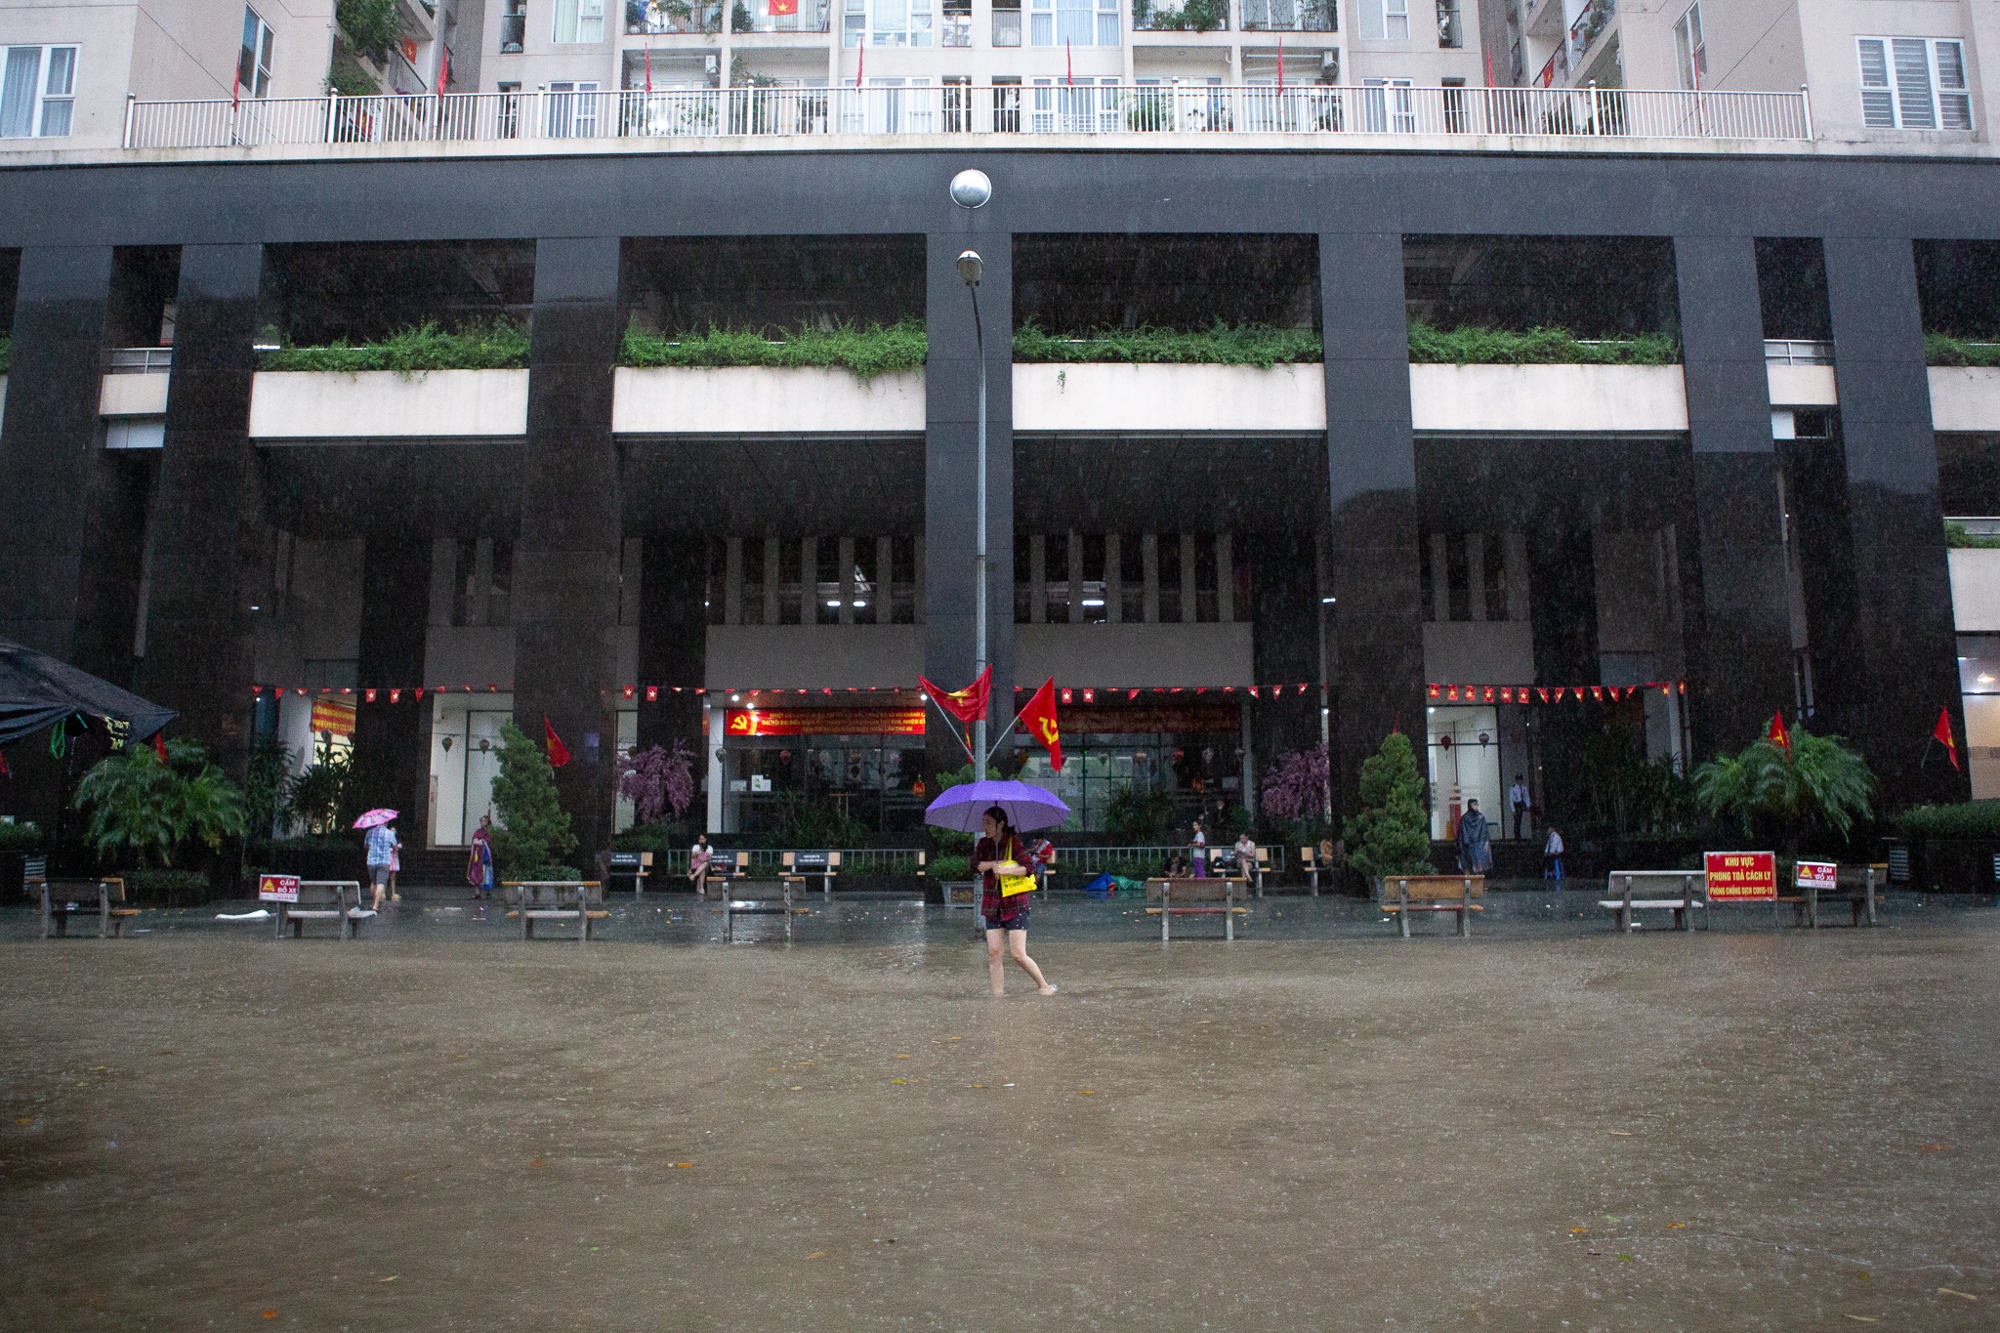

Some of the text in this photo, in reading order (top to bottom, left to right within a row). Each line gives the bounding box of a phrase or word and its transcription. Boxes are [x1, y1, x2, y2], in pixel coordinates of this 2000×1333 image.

[1725, 856, 1754, 868] KHU VỰC
[1817, 865, 1833, 873] CẤM
[1709, 871, 1731, 881] PHONG
[1745, 869, 1763, 881] CÁCH
[1764, 871, 1772, 880] LY
[280, 878, 295, 886] CẤM
[1753, 886, 1773, 895] COVID-19
